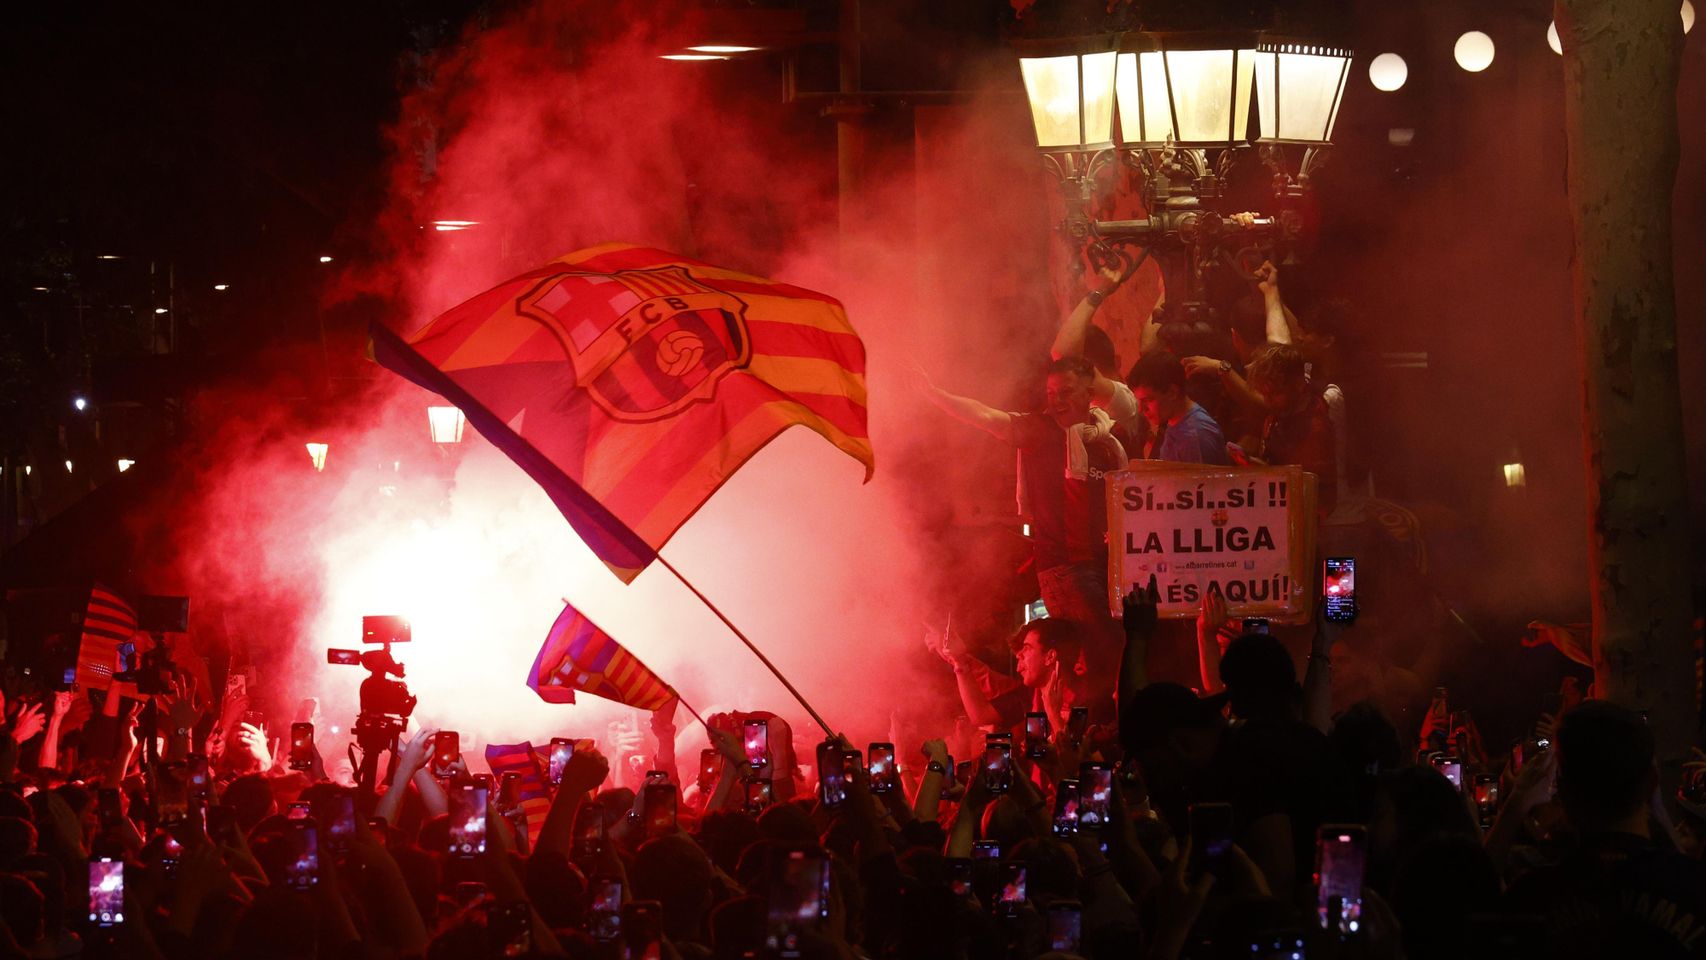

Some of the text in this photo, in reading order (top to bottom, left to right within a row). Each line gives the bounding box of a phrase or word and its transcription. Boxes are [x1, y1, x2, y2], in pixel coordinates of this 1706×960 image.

[1089, 466, 1106, 481] Sp
[1126, 526, 1276, 554] LA LLIGA
[1167, 579, 1199, 604] ÉS
[1205, 573, 1289, 604] AQUÍ!
